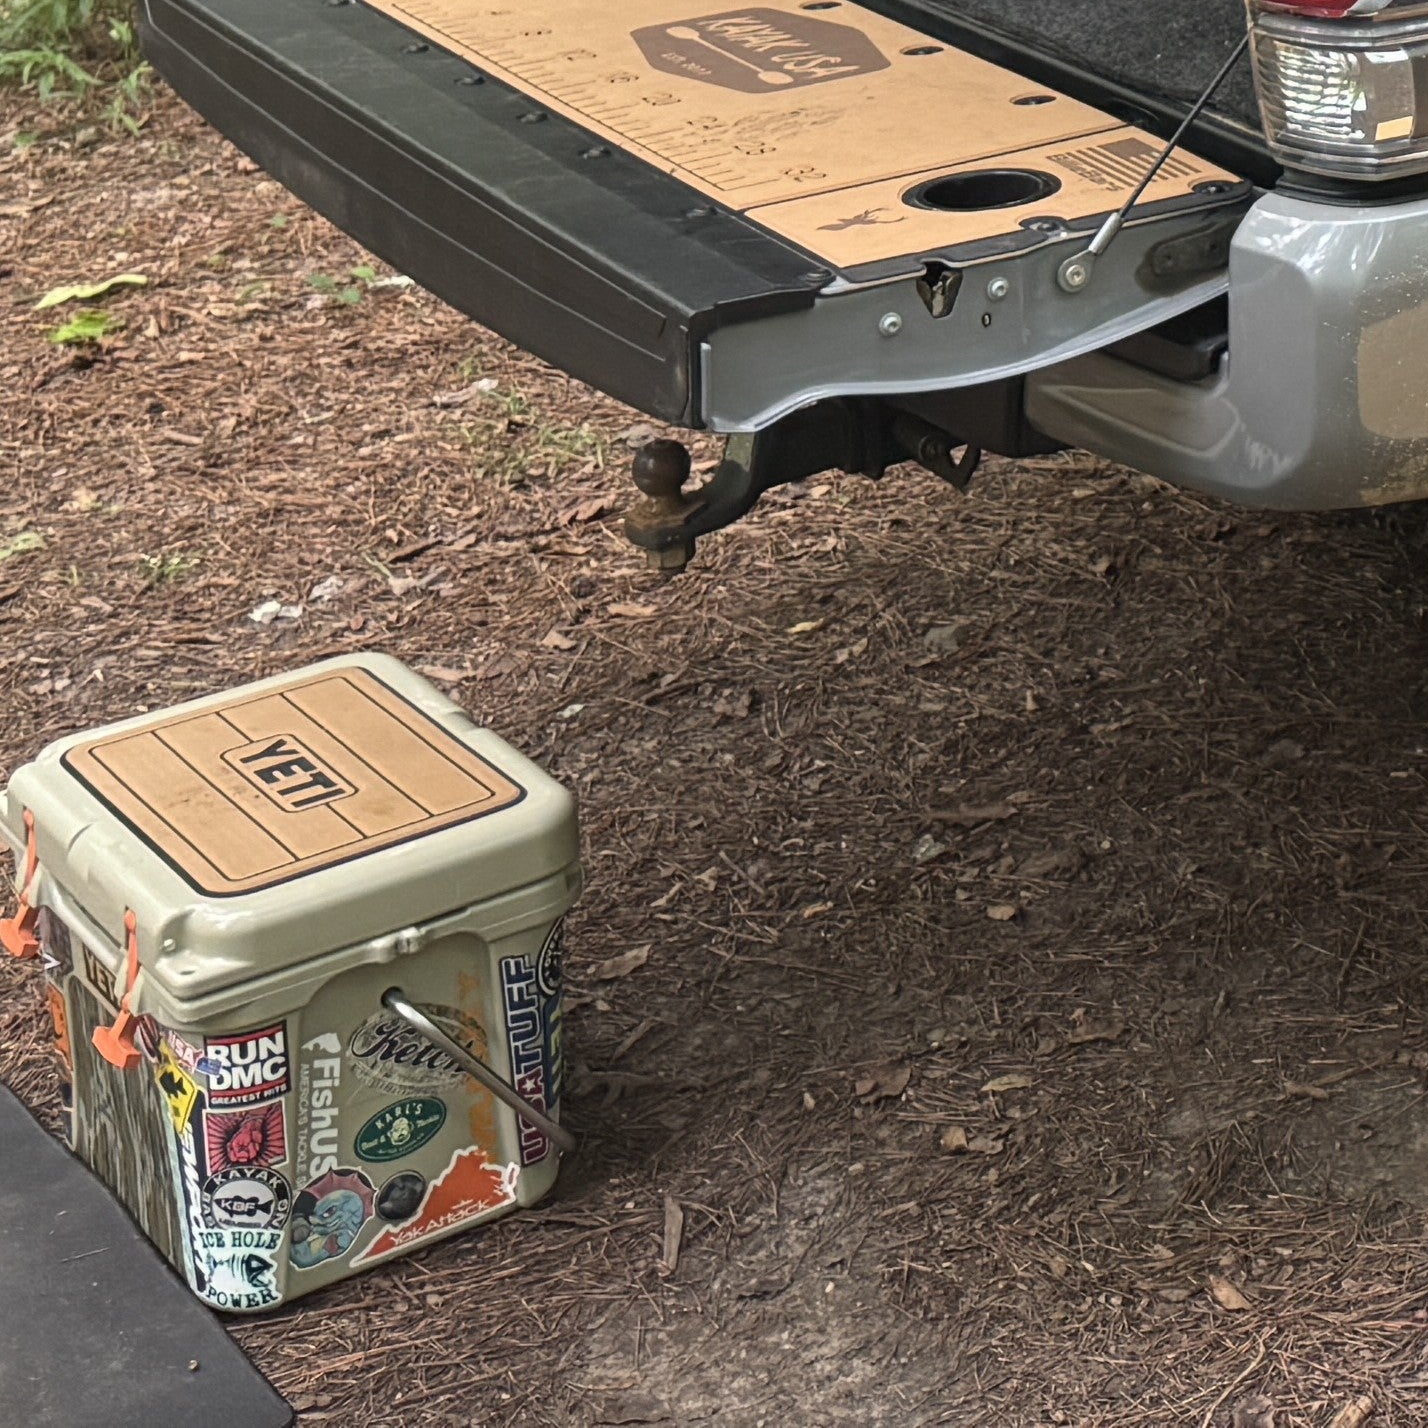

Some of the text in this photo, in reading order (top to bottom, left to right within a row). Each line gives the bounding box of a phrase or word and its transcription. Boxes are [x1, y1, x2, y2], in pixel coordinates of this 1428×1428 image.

[697, 15, 862, 79] KAYAK USA
[642, 93, 682, 107] 20
[239, 738, 347, 809] YETI
[206, 1030, 285, 1068] RUN
[208, 1055, 287, 1091] DMC
[210, 1092, 261, 1105] GREATEST
[309, 1057, 342, 1180] FishUS
[212, 1168, 282, 1189] KAYAK
[199, 1231, 282, 1250] ICE HOLE
[206, 1288, 279, 1309] POWER
